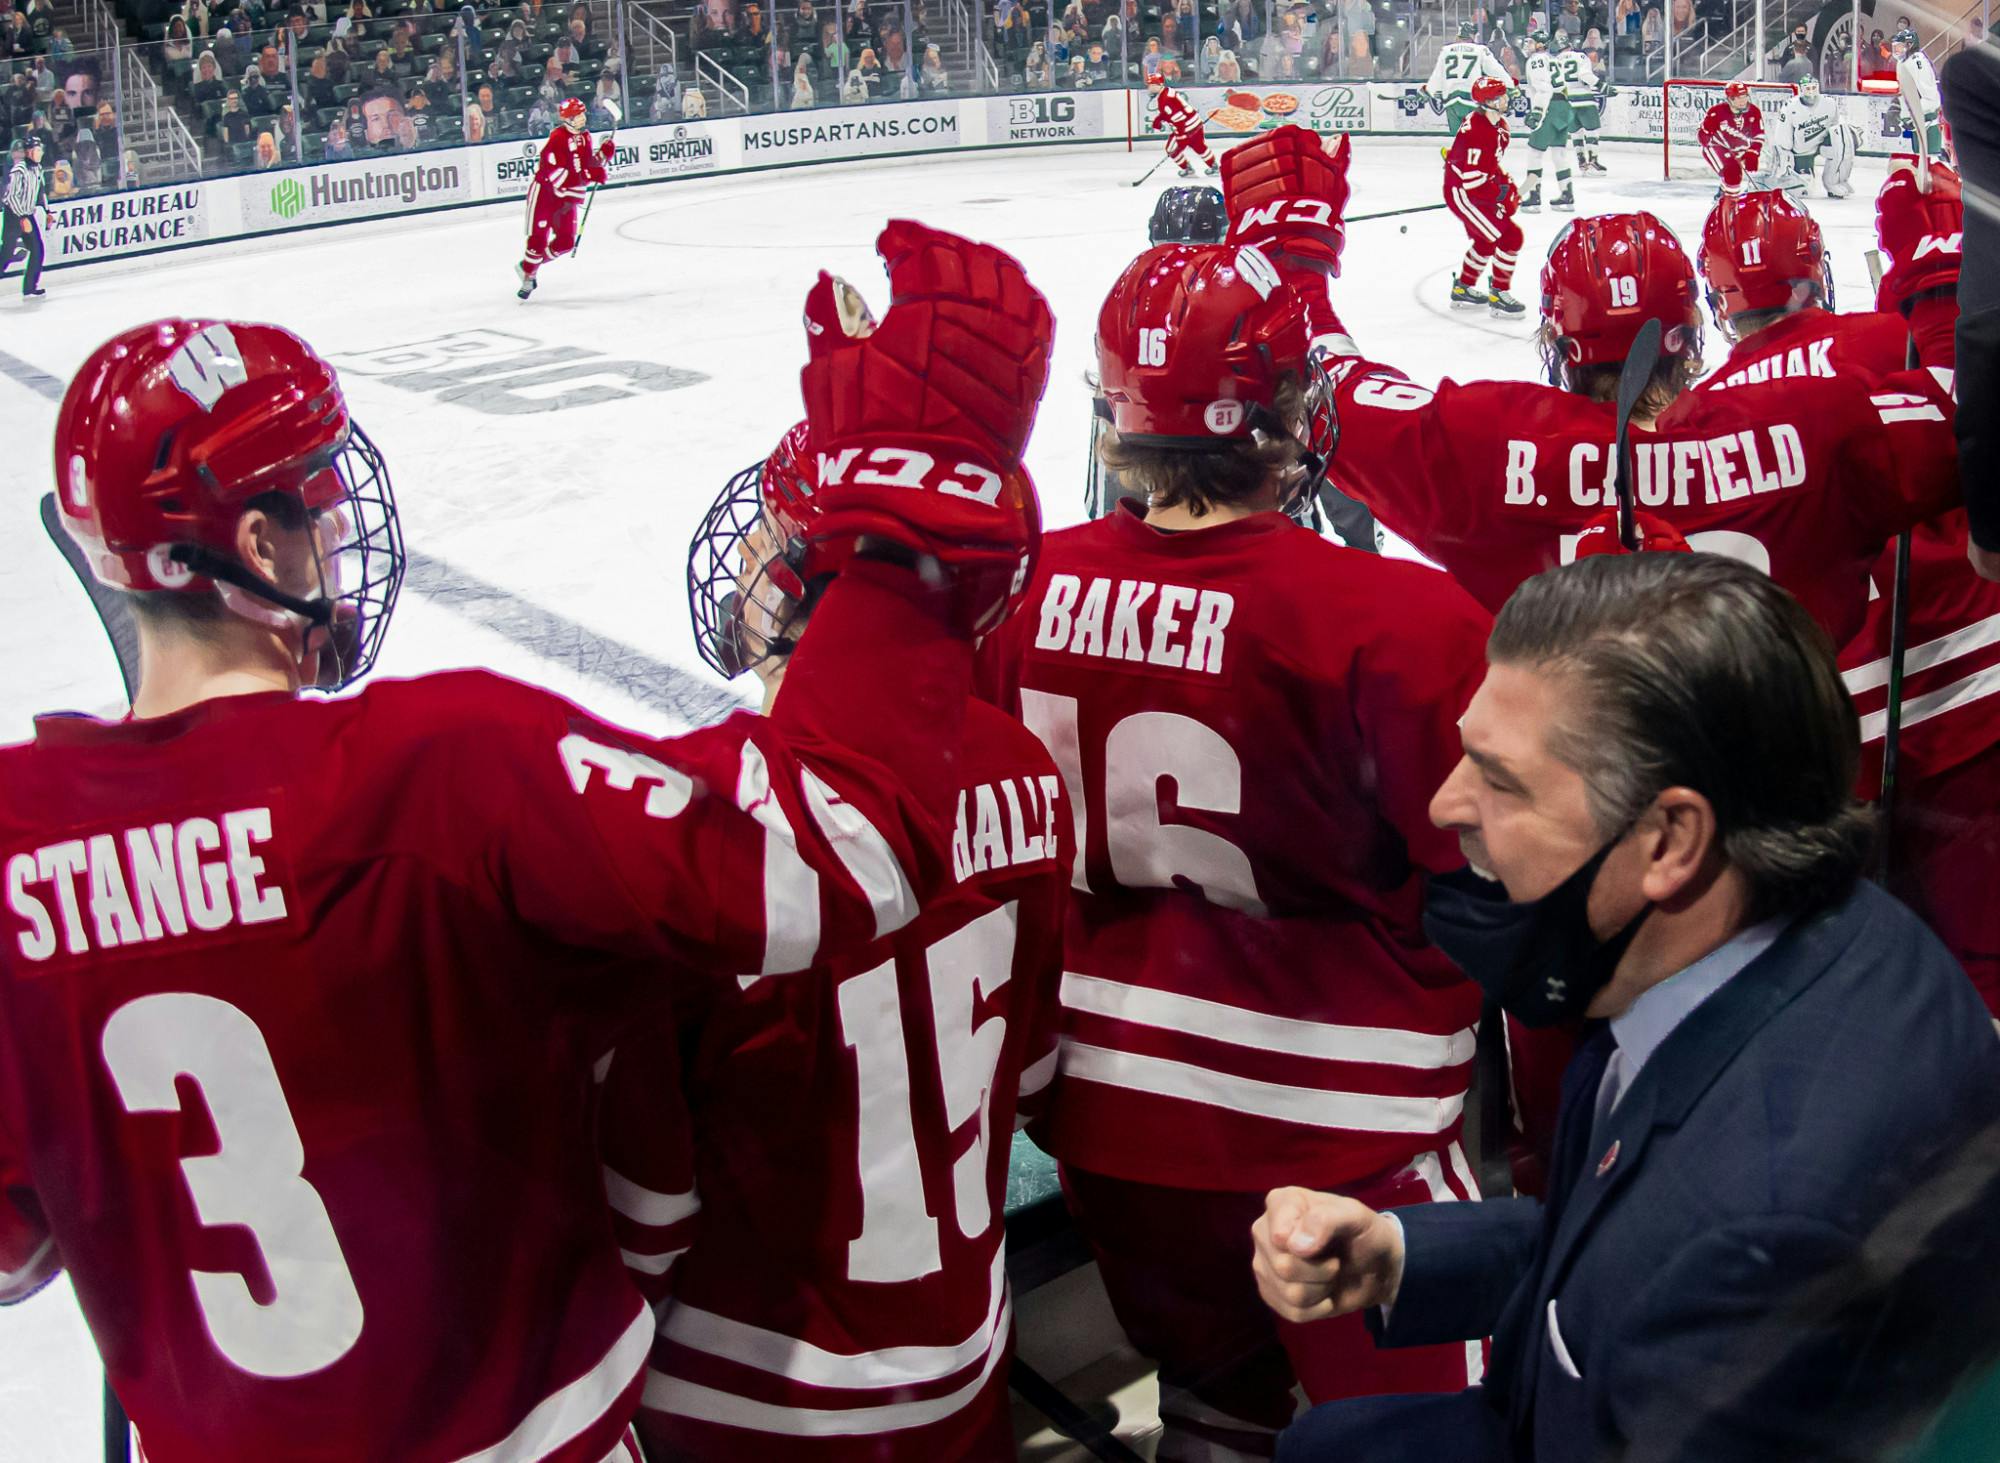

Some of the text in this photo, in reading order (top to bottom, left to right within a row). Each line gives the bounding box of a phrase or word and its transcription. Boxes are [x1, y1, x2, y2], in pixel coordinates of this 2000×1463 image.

[1445, 55, 1478, 79] 27
[1531, 59, 1544, 69] 23
[1632, 90, 1662, 107] Jan
[649, 138, 713, 161] SPARTAN
[744, 116, 957, 150] MSUSPARTANS.COM
[1010, 126, 1076, 139] NETWORK
[497, 157, 540, 180] SPAR
[1467, 147, 1482, 165] 17
[310, 165, 459, 206] Huntington
[111, 189, 199, 220] BUREAU
[1236, 199, 1344, 235] CM
[1741, 237, 1762, 266] 11
[1609, 275, 1638, 307] 19
[1138, 328, 1166, 367] 16
[1505, 439, 1548, 506] B.
[1035, 573, 1235, 674] BAKER
[557, 733, 694, 819] 3
[1020, 687, 1270, 919] 16
[6, 807, 288, 961] STANGE
[837, 900, 1019, 1284] 15
[101, 992, 364, 1379] 3
